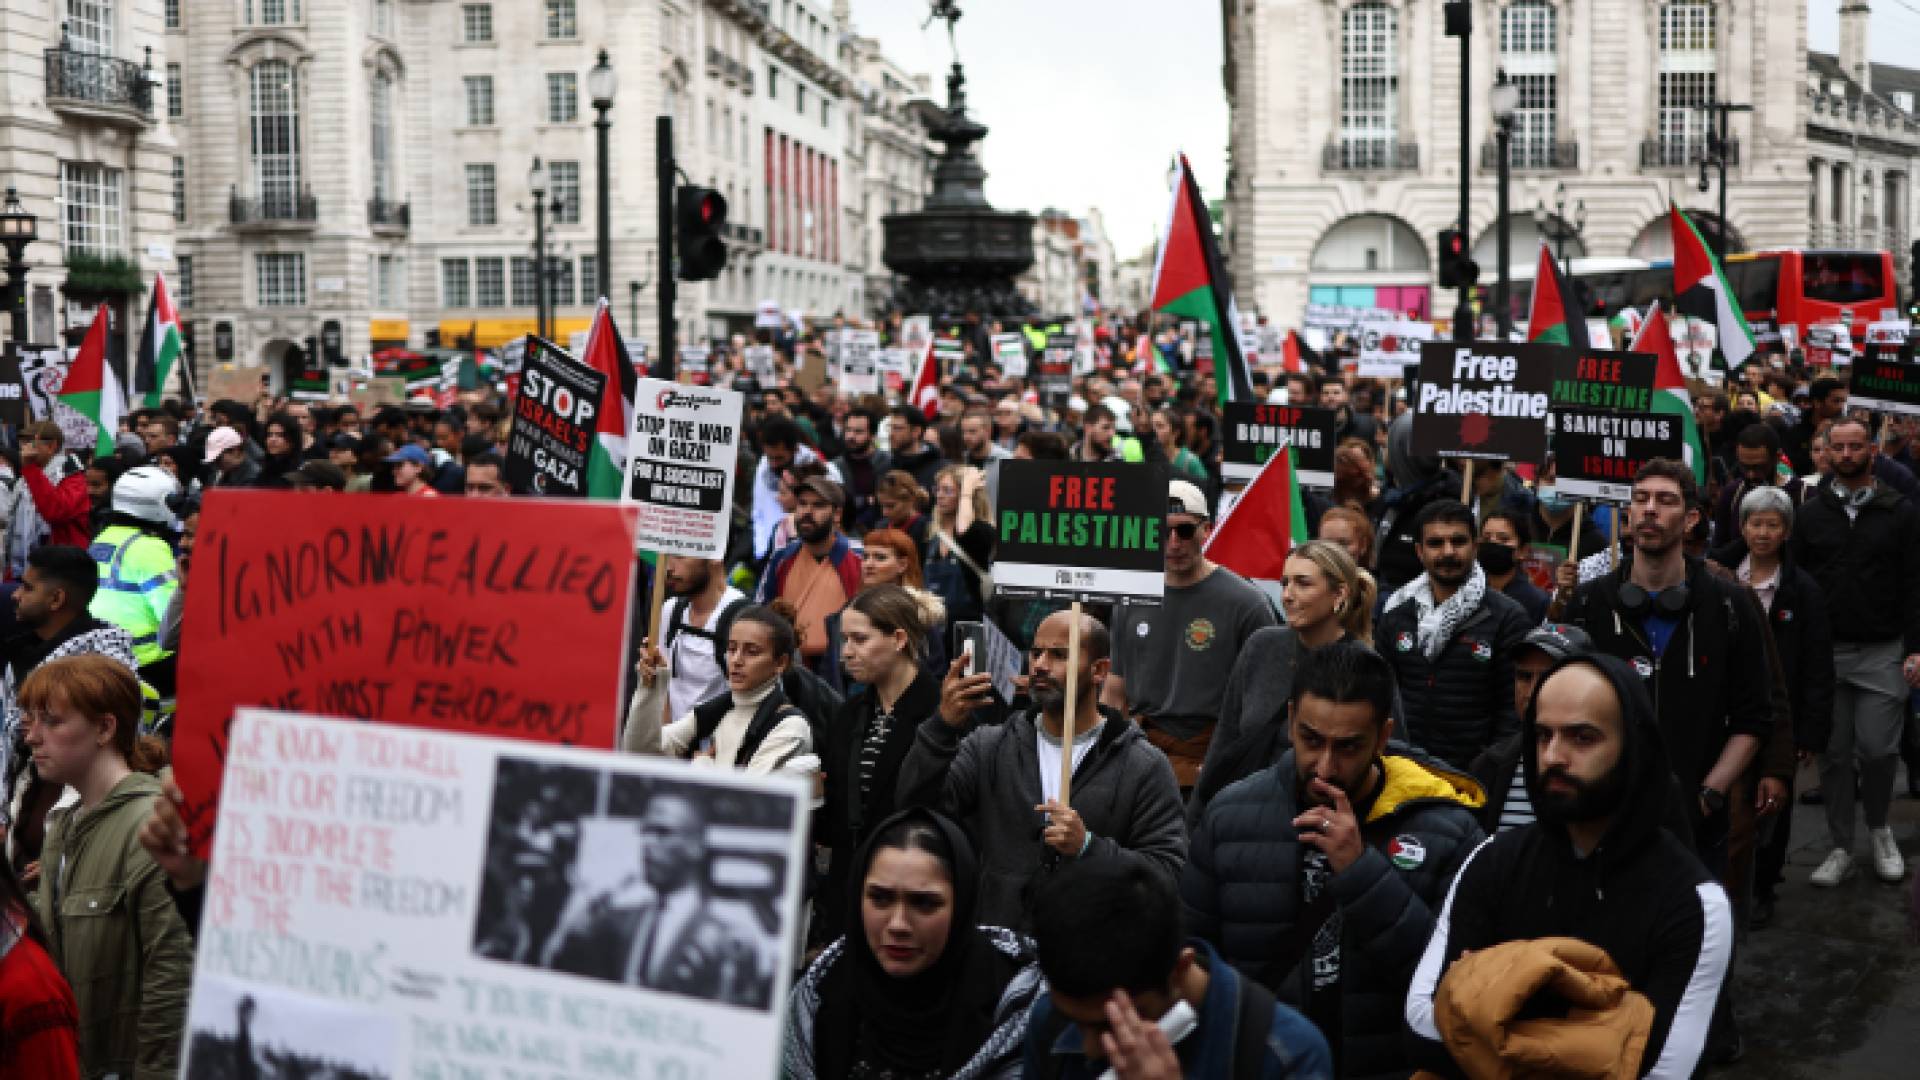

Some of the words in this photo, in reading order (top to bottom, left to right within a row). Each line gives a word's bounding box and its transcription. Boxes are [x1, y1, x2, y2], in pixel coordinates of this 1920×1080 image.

[1453, 348, 1518, 381] Free
[1577, 356, 1623, 383] FREE
[523, 370, 595, 425] STOP
[1418, 383, 1548, 419] Palestine
[1552, 380, 1649, 411] PALESTINE
[518, 396, 587, 453] ISRAEL'S
[637, 413, 665, 434] STOP
[669, 418, 694, 440] THE
[699, 423, 732, 445] WAR
[1255, 405, 1302, 426] STOP
[1563, 413, 1670, 440] SANCTIONS
[648, 437, 664, 456] ON
[669, 440, 710, 462] GAZA!
[1237, 424, 1321, 449] BOMBING
[1603, 437, 1626, 457] ON
[534, 448, 579, 491] GAZA
[1048, 474, 1117, 510] FREE
[1001, 511, 1161, 550] PALESTINE
[276, 608, 363, 677] WITH
[386, 606, 518, 667] POWER
[316, 679, 392, 722] MOST
